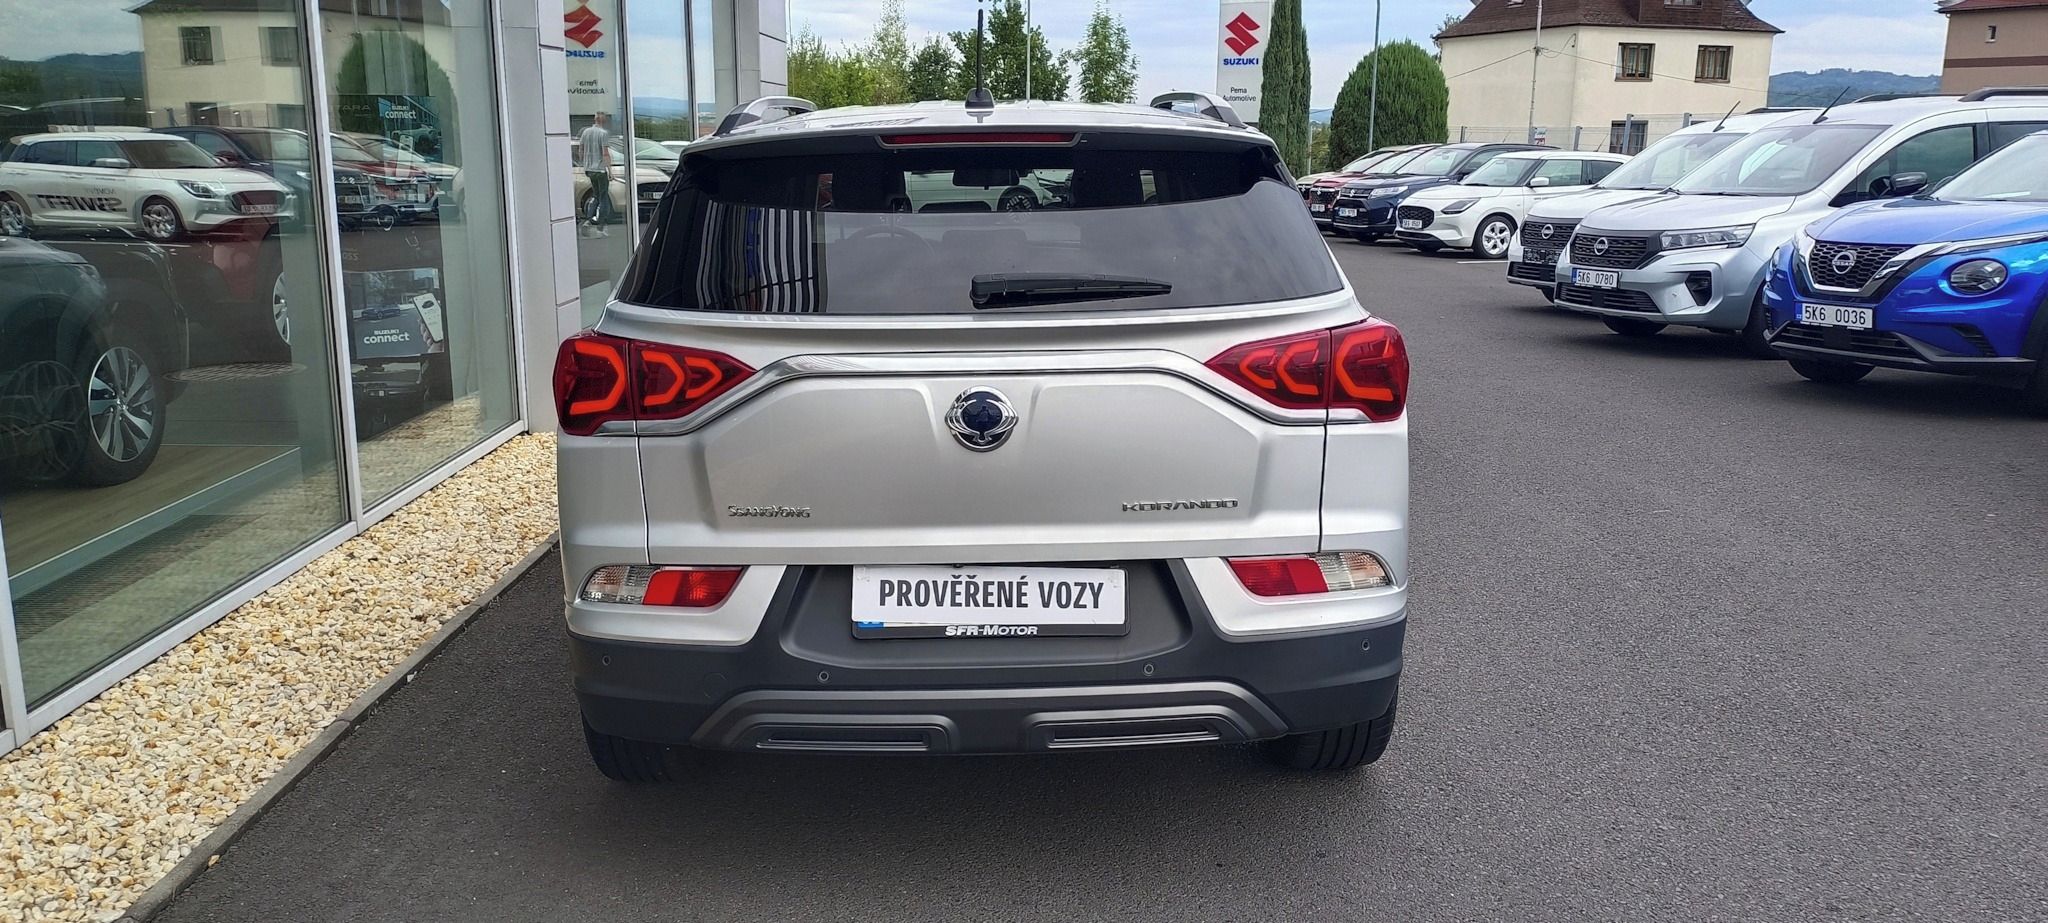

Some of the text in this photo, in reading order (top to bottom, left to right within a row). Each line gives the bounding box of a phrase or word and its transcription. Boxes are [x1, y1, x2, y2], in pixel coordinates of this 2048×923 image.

[1223, 58, 1259, 66] SUZUKI
[385, 110, 416, 119] connect
[1577, 271, 1614, 286] 5K6 0780
[1804, 305, 1866, 325] 5K6 0036
[363, 333, 410, 344] connect
[1122, 499, 1239, 512] KORANDO
[879, 575, 1104, 610] PROVĚŘENÉ VOZY
[945, 625, 1039, 637] SFR-MOTOR
